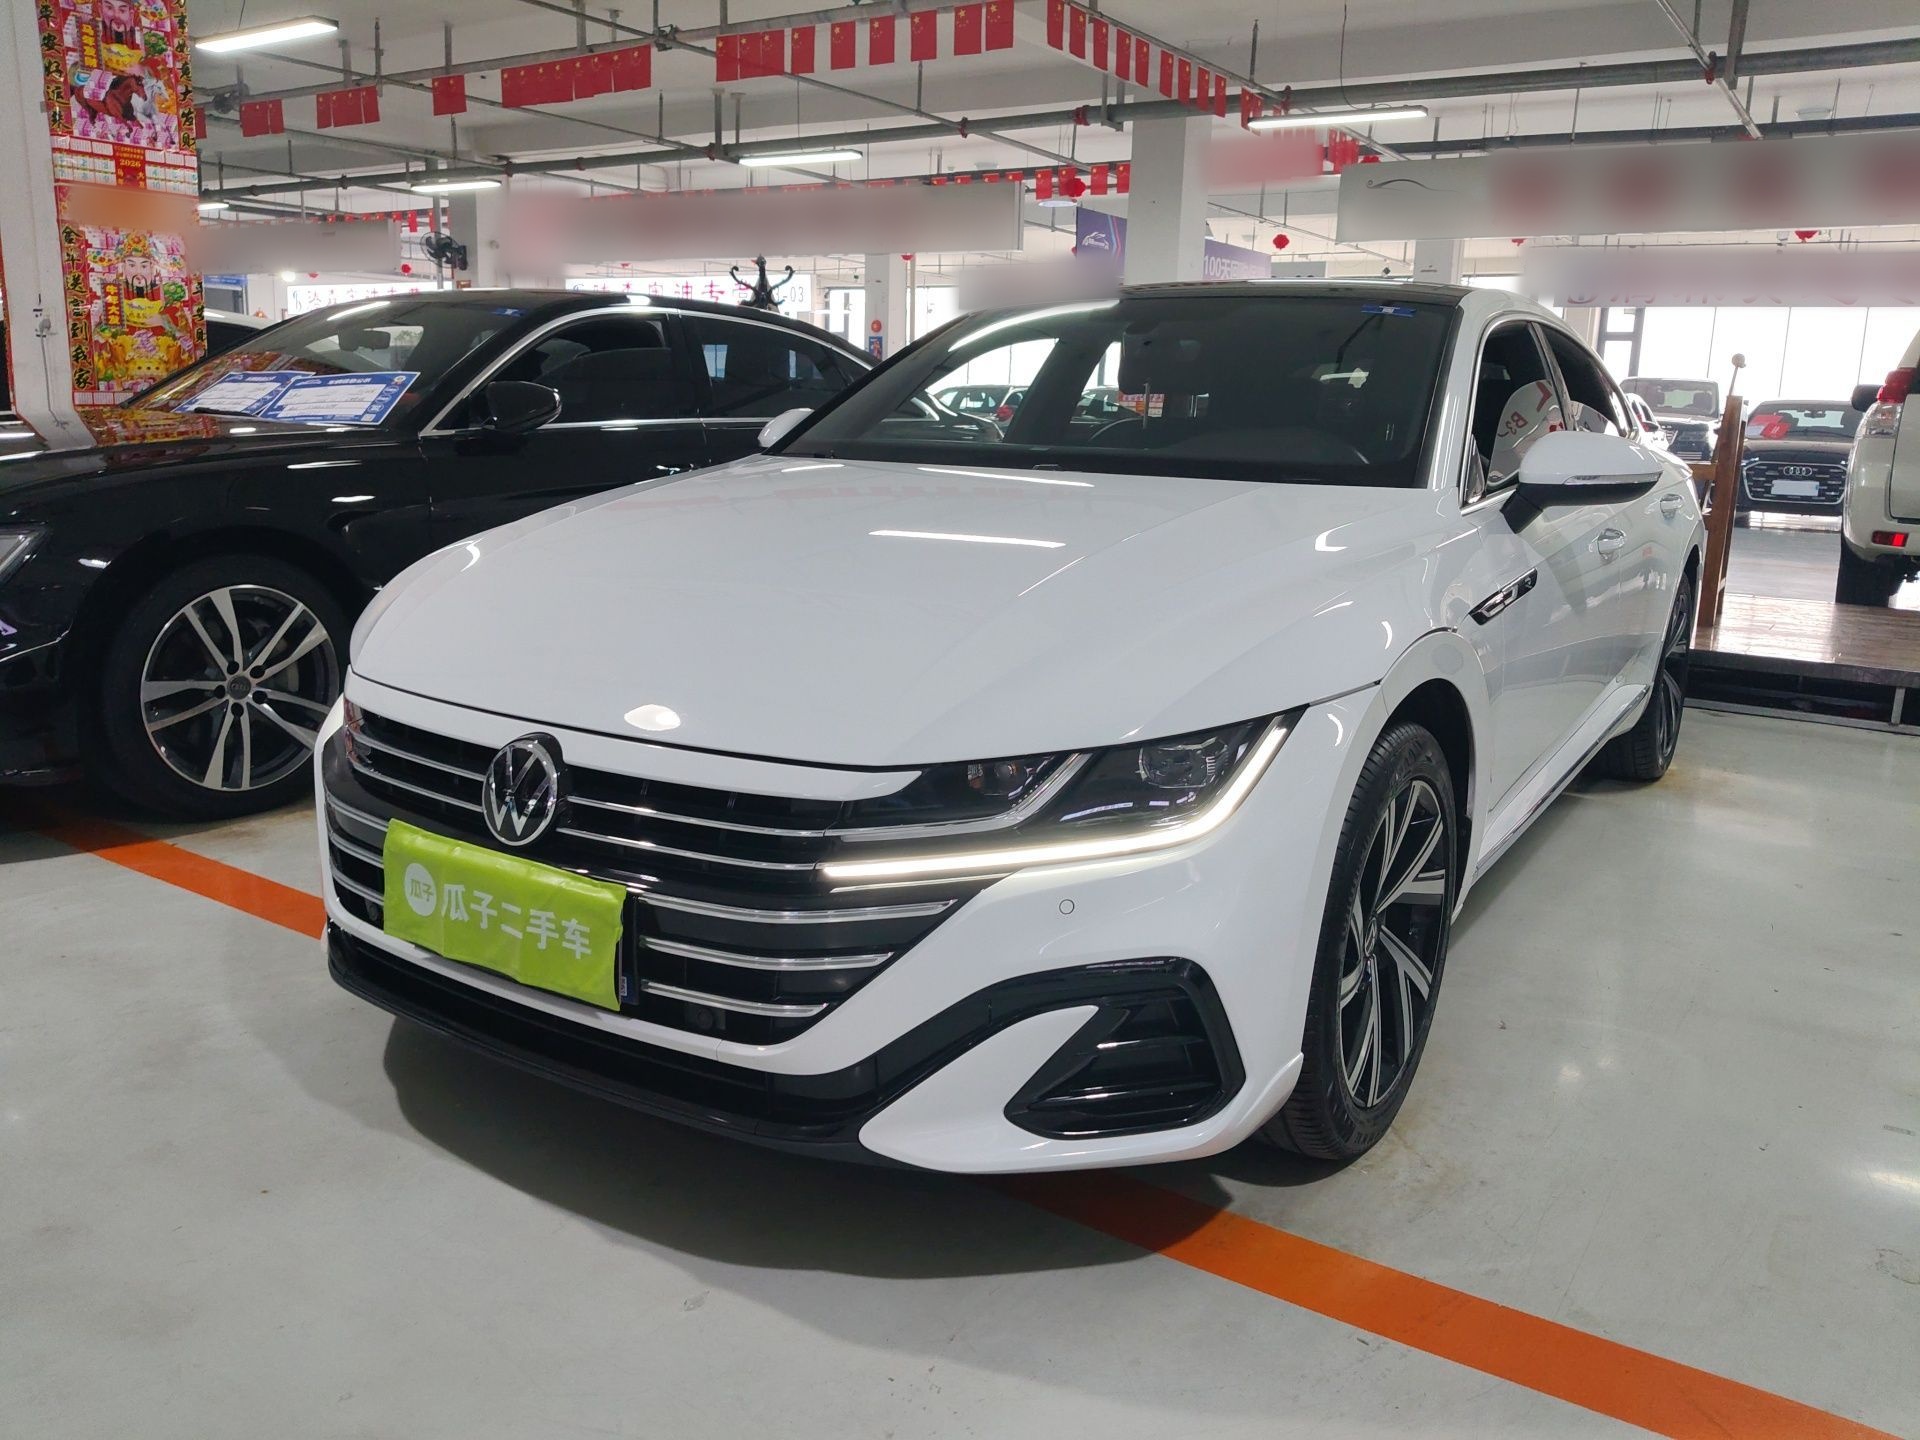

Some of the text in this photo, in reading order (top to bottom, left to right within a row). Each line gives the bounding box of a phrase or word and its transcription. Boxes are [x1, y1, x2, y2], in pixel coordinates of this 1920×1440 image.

[119, 159, 142, 168] 2026
[410, 878, 434, 903] 瓜子
[440, 883, 592, 960] 瓜子二手车
